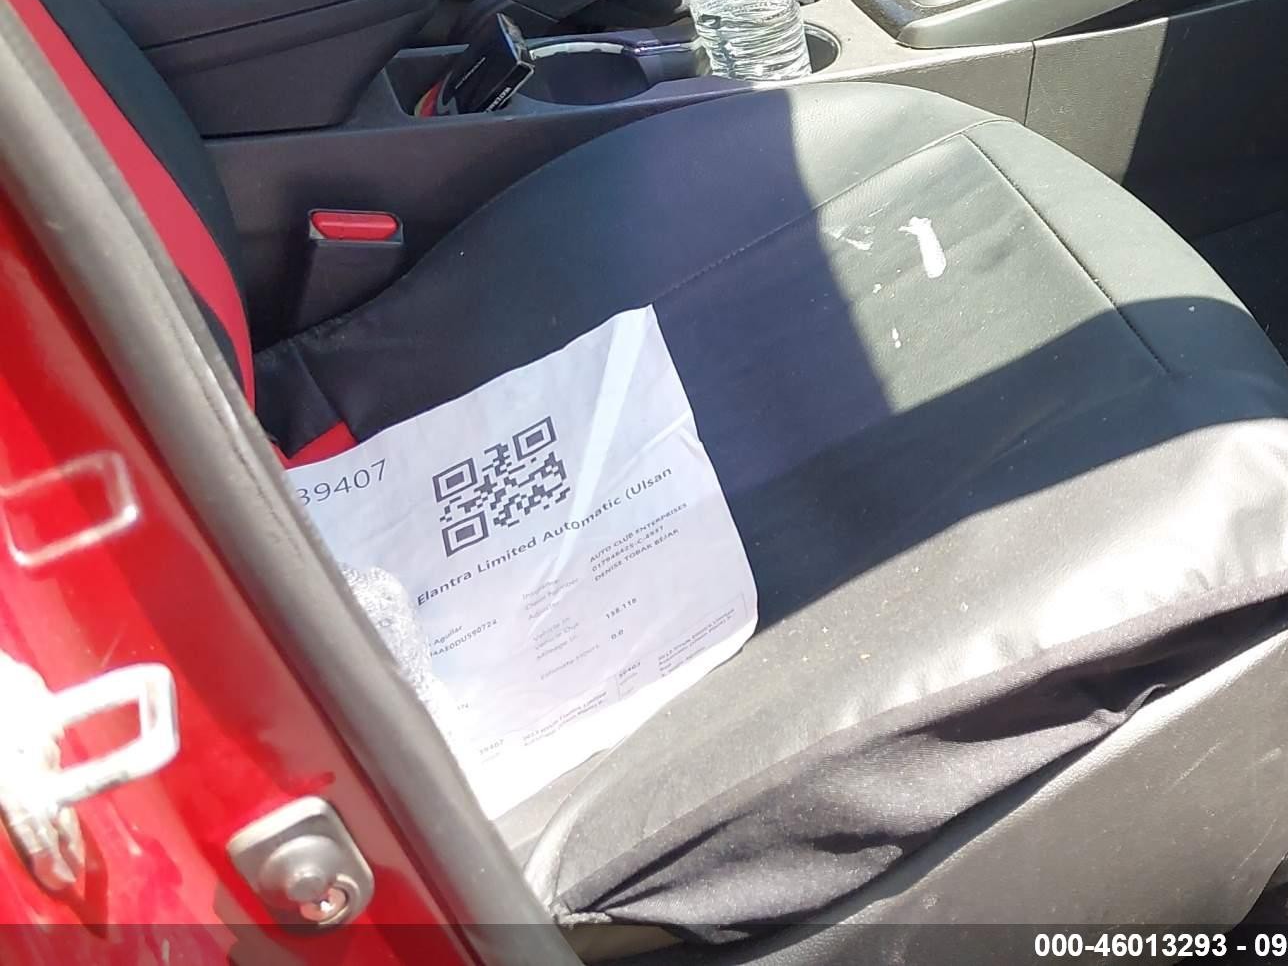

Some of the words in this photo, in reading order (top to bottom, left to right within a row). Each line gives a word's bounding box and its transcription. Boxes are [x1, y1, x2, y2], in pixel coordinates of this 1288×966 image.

[416, 570, 473, 607] Elantra
[477, 536, 538, 574] Limited
[542, 496, 622, 543] Automatic
[625, 466, 673, 501] (Ulsan
